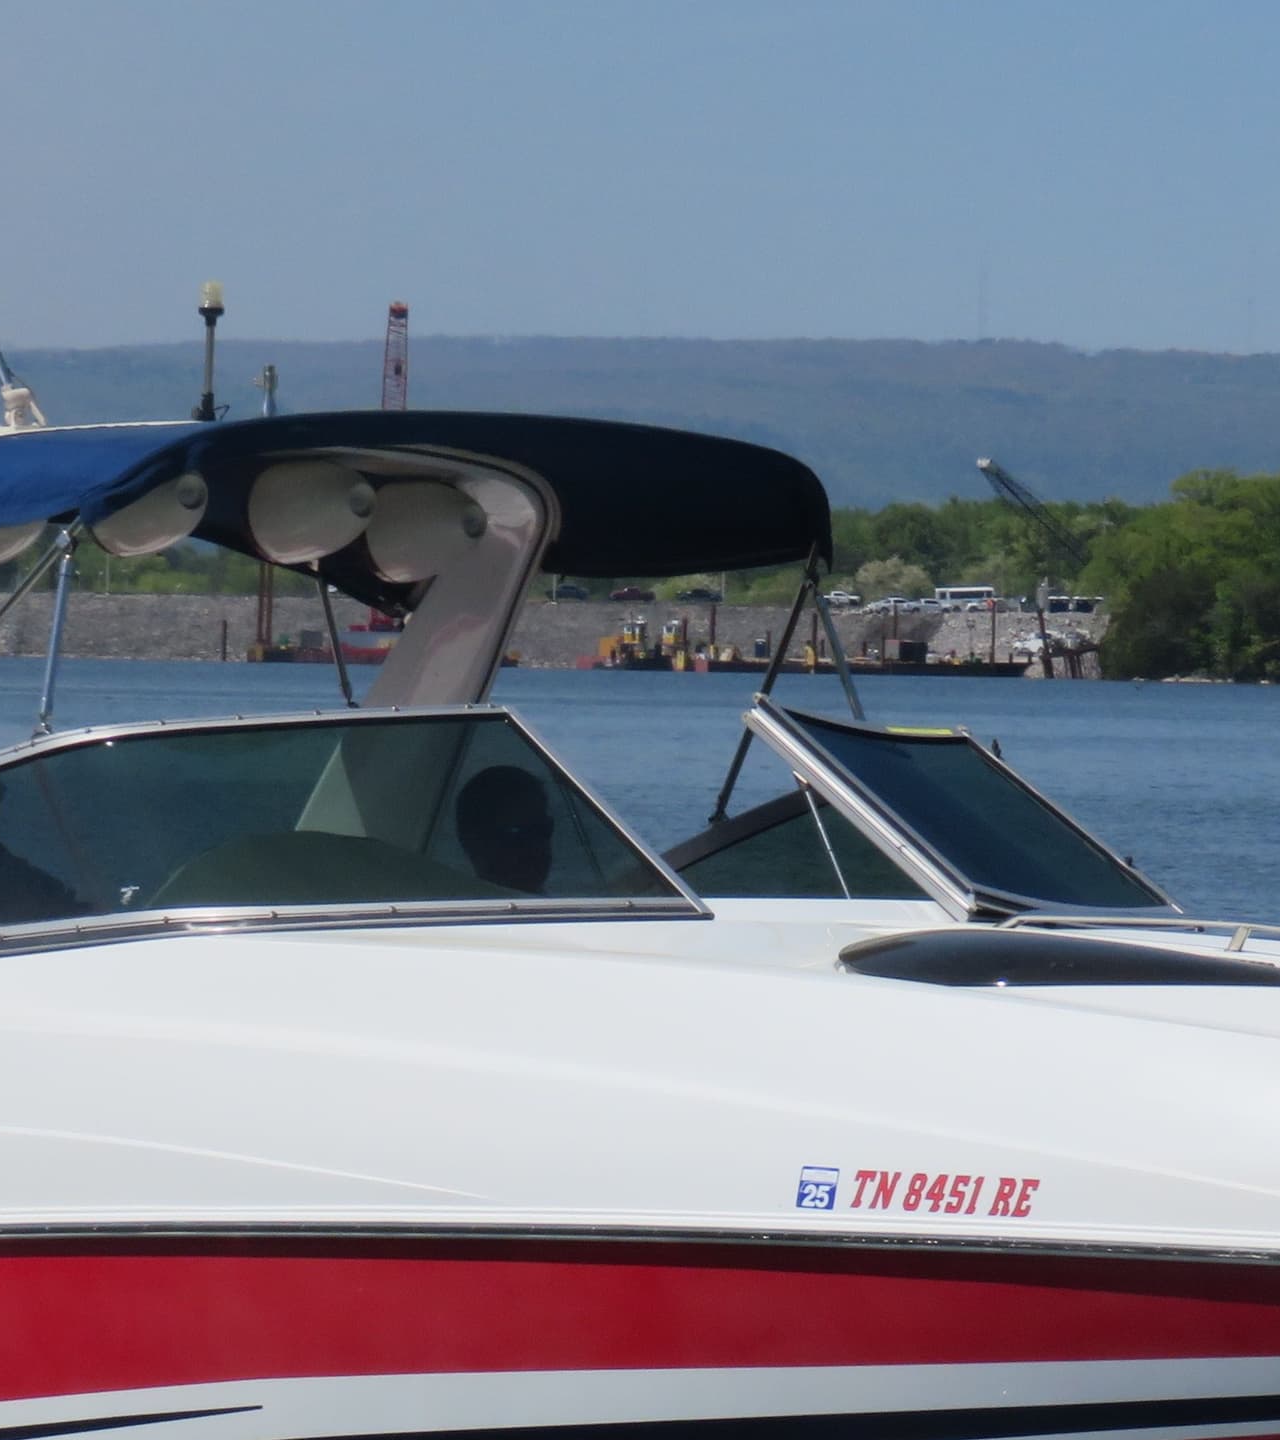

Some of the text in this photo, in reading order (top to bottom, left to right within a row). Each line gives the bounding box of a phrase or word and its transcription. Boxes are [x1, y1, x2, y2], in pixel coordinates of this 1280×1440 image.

[800, 1184, 830, 1208] 25
[850, 1170, 1040, 1218] TN 8451 RE
